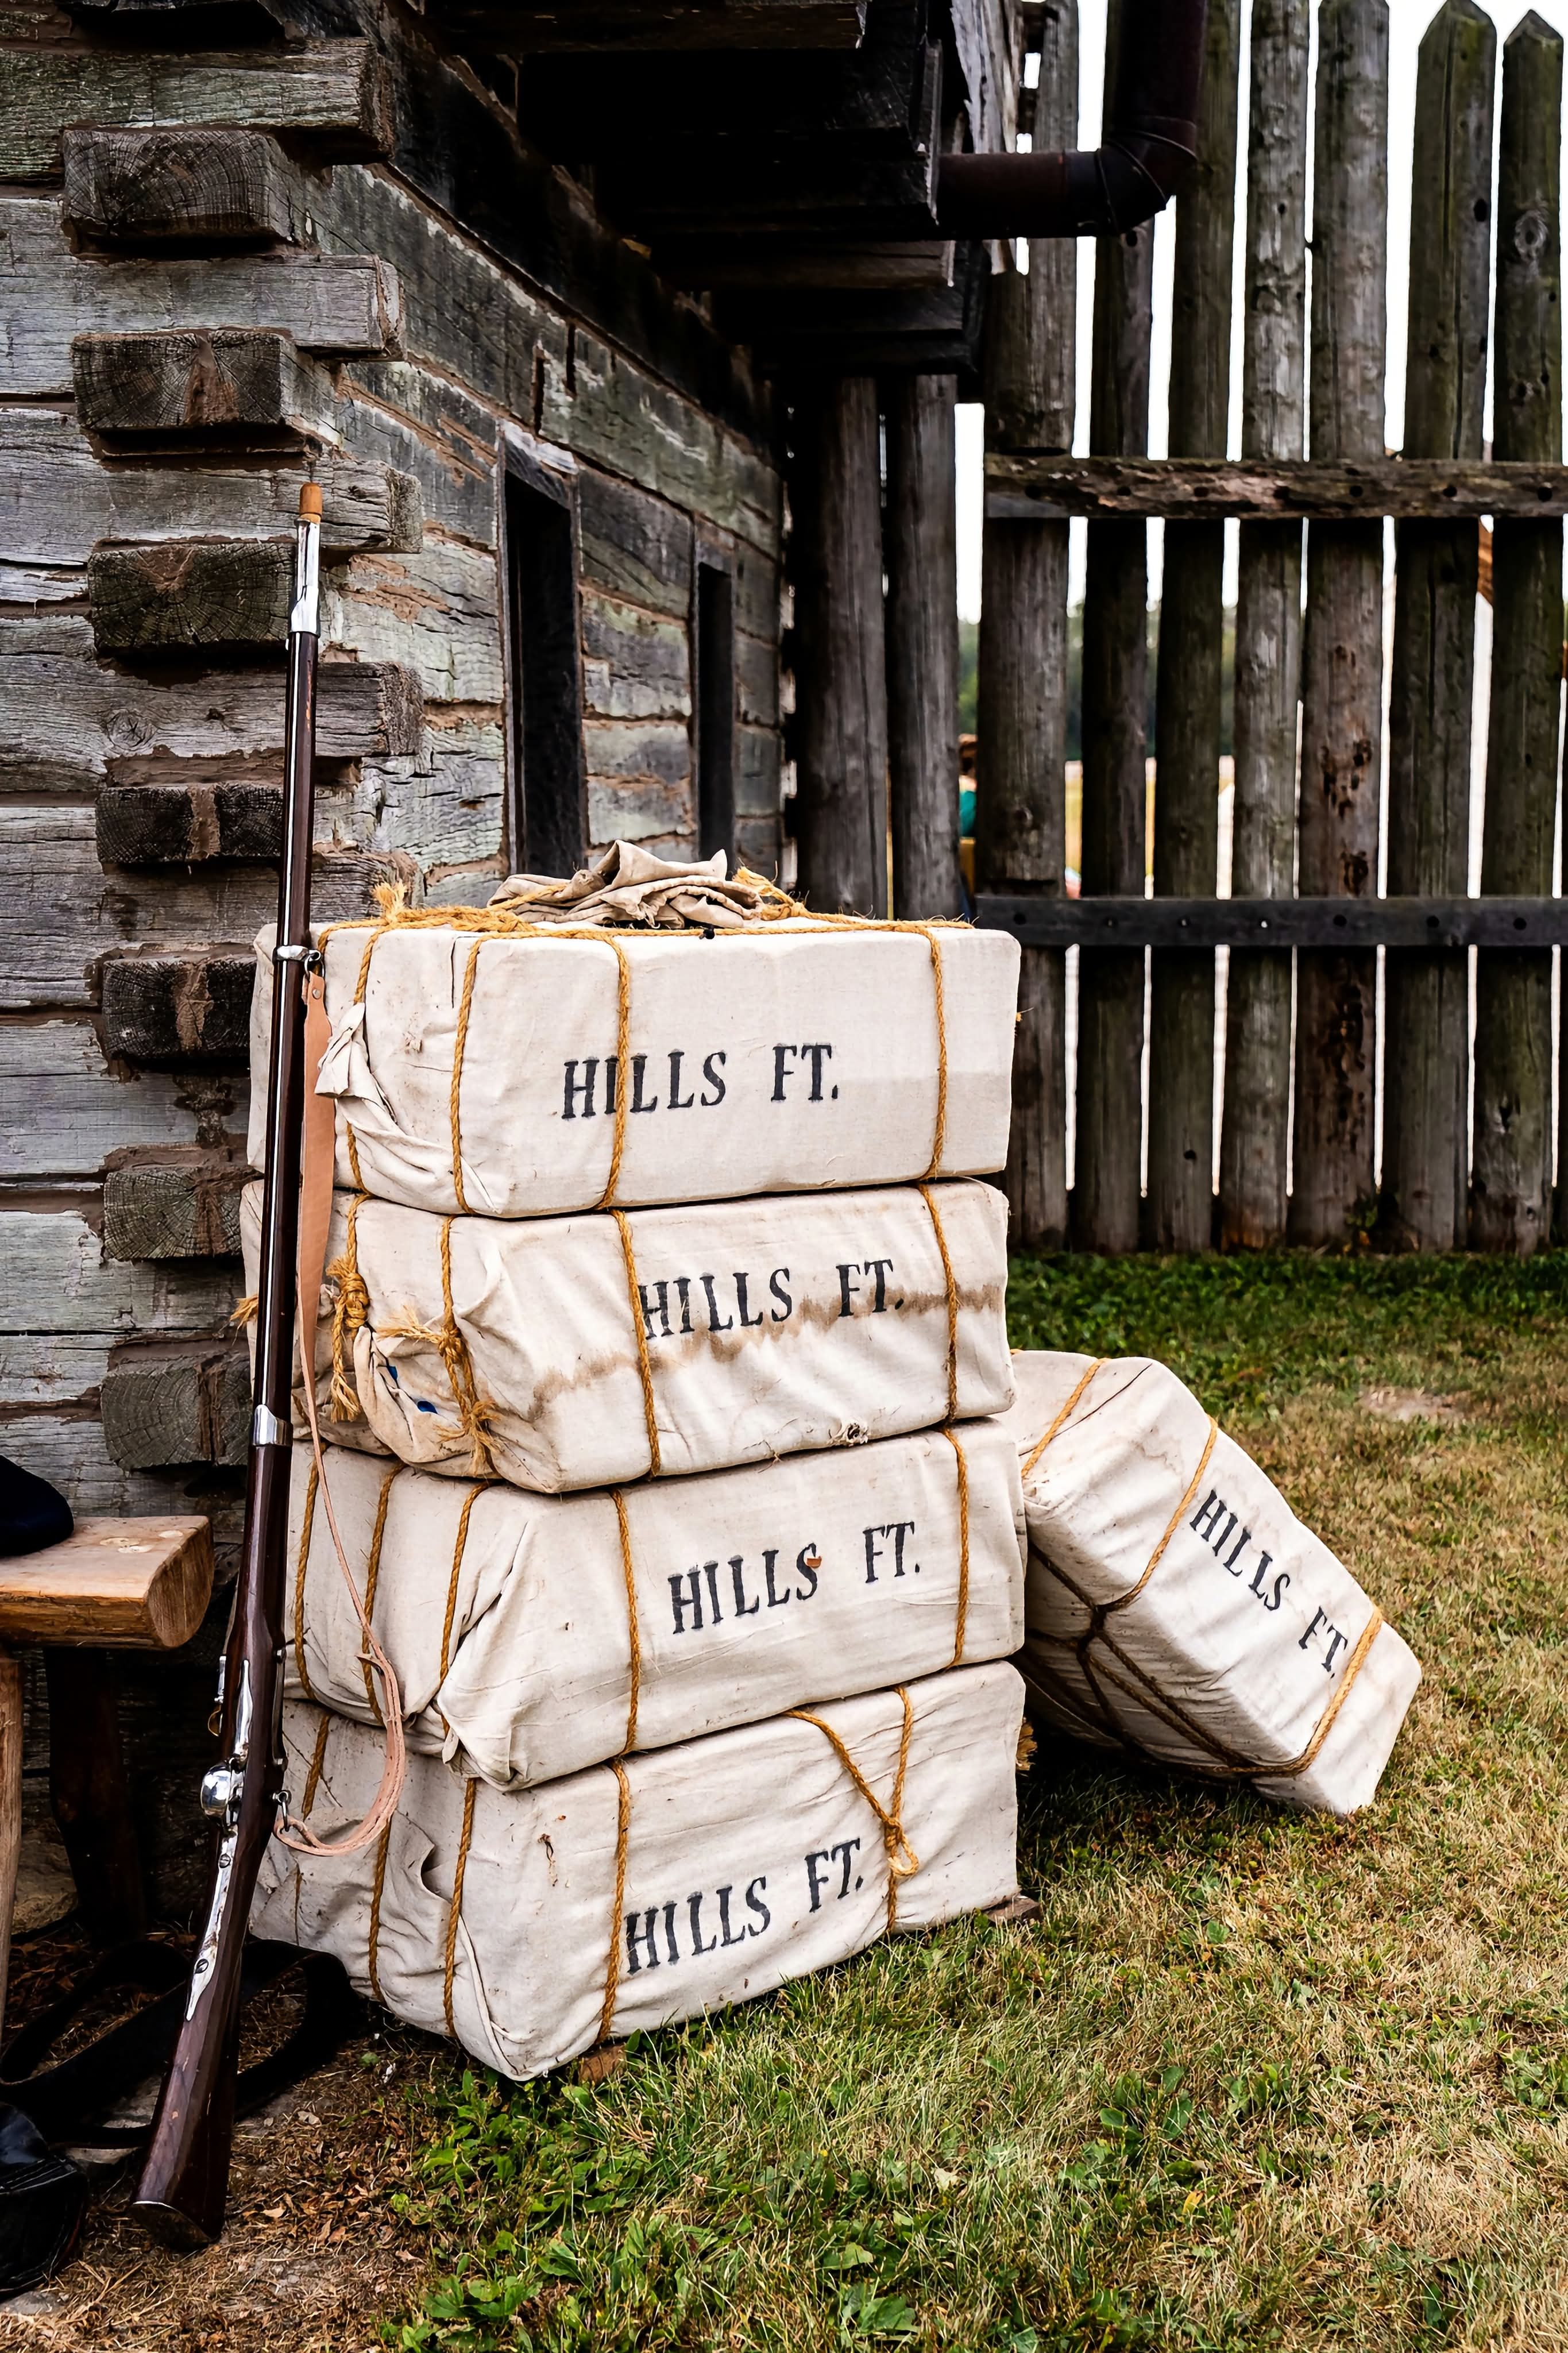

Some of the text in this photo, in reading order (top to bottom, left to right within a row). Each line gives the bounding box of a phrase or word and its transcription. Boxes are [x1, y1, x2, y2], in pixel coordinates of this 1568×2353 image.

[561, 1044, 839, 1119] HILLS FT.
[638, 1259, 904, 1340] HILLS FT.
[668, 1522, 920, 1634] HILLS FT.
[1189, 1489, 1349, 1679] HILLS FT.
[624, 1838, 864, 1974] HILLS FT.
